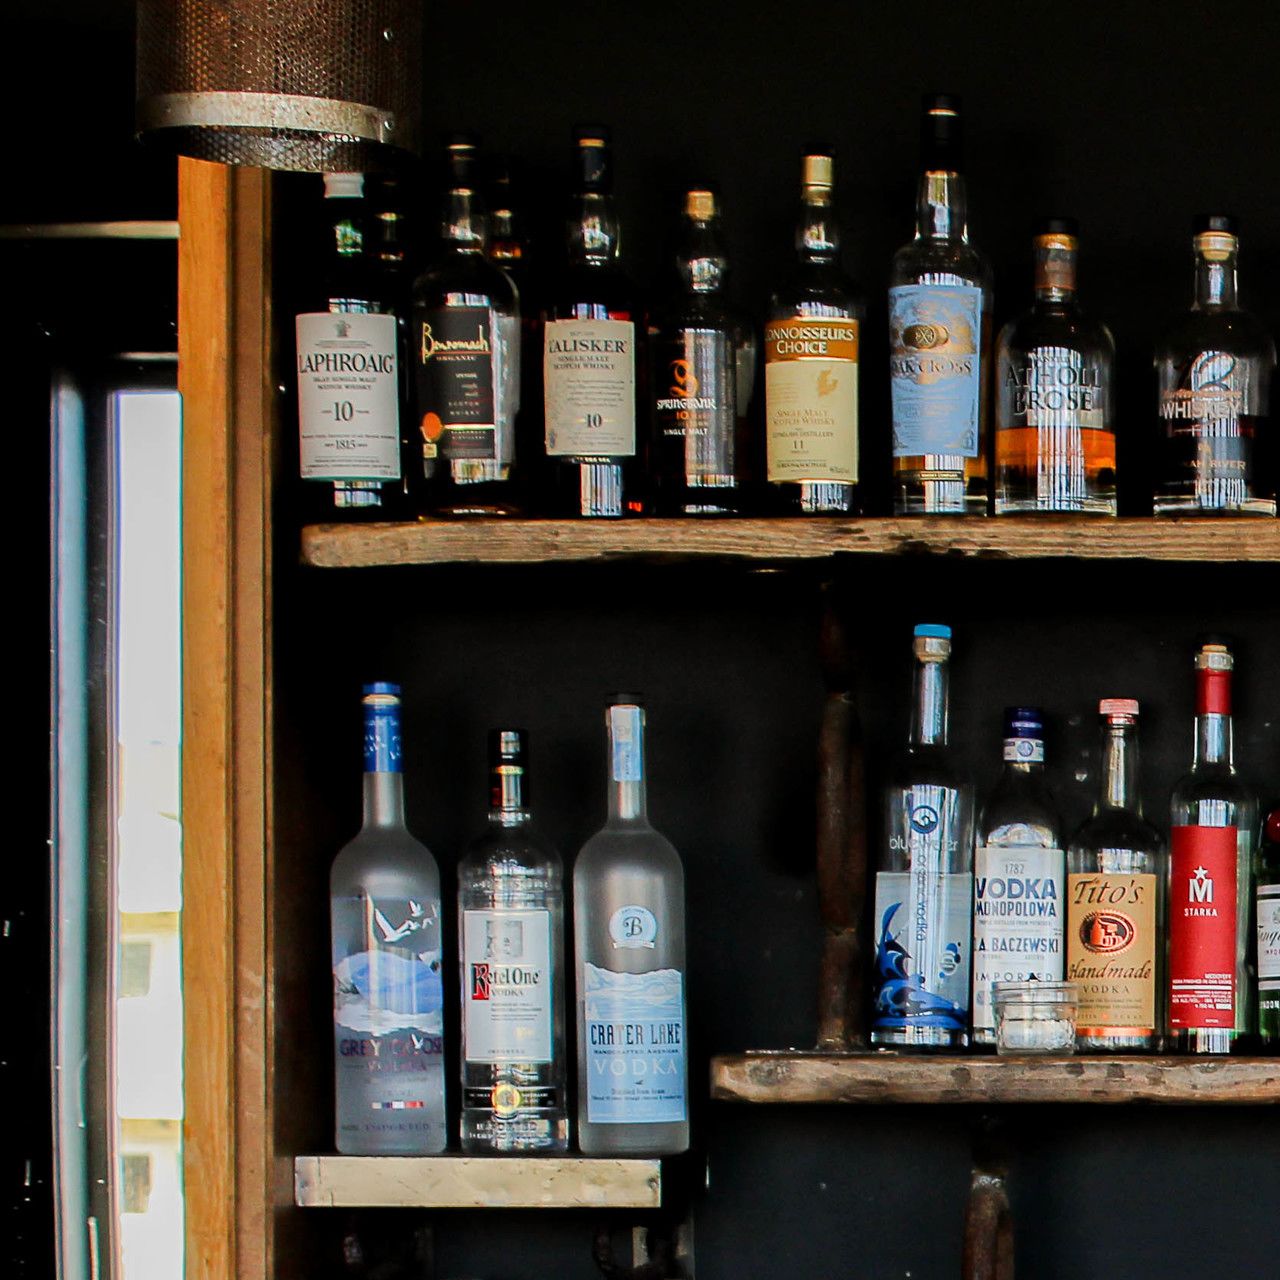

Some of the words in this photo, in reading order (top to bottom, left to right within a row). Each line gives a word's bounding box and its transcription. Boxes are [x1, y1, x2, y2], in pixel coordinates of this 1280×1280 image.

[776, 341, 827, 354] CHOICE
[300, 353, 394, 373] LAPHROAIG
[334, 401, 353, 421] 10
[586, 413, 602, 428] 10
[1005, 863, 1024, 874] 1782
[975, 878, 1057, 899] VODKA
[1074, 877, 1143, 904] Tito's
[1189, 879, 1213, 903] M
[975, 901, 1057, 917] MONOPOLOWA
[1184, 908, 1217, 917] STARKA
[992, 938, 1059, 953] BACZEWSKI
[512, 967, 540, 985] One
[976, 972, 1053, 982] IMPORED
[1069, 959, 1152, 979] Handmade
[491, 988, 524, 997] VODKA
[1083, 985, 1130, 993] VODKA
[591, 1024, 643, 1045] CRATER
[651, 1023, 681, 1044] LAKE
[340, 1039, 379, 1056] GREY
[594, 1057, 677, 1076] VODKA
